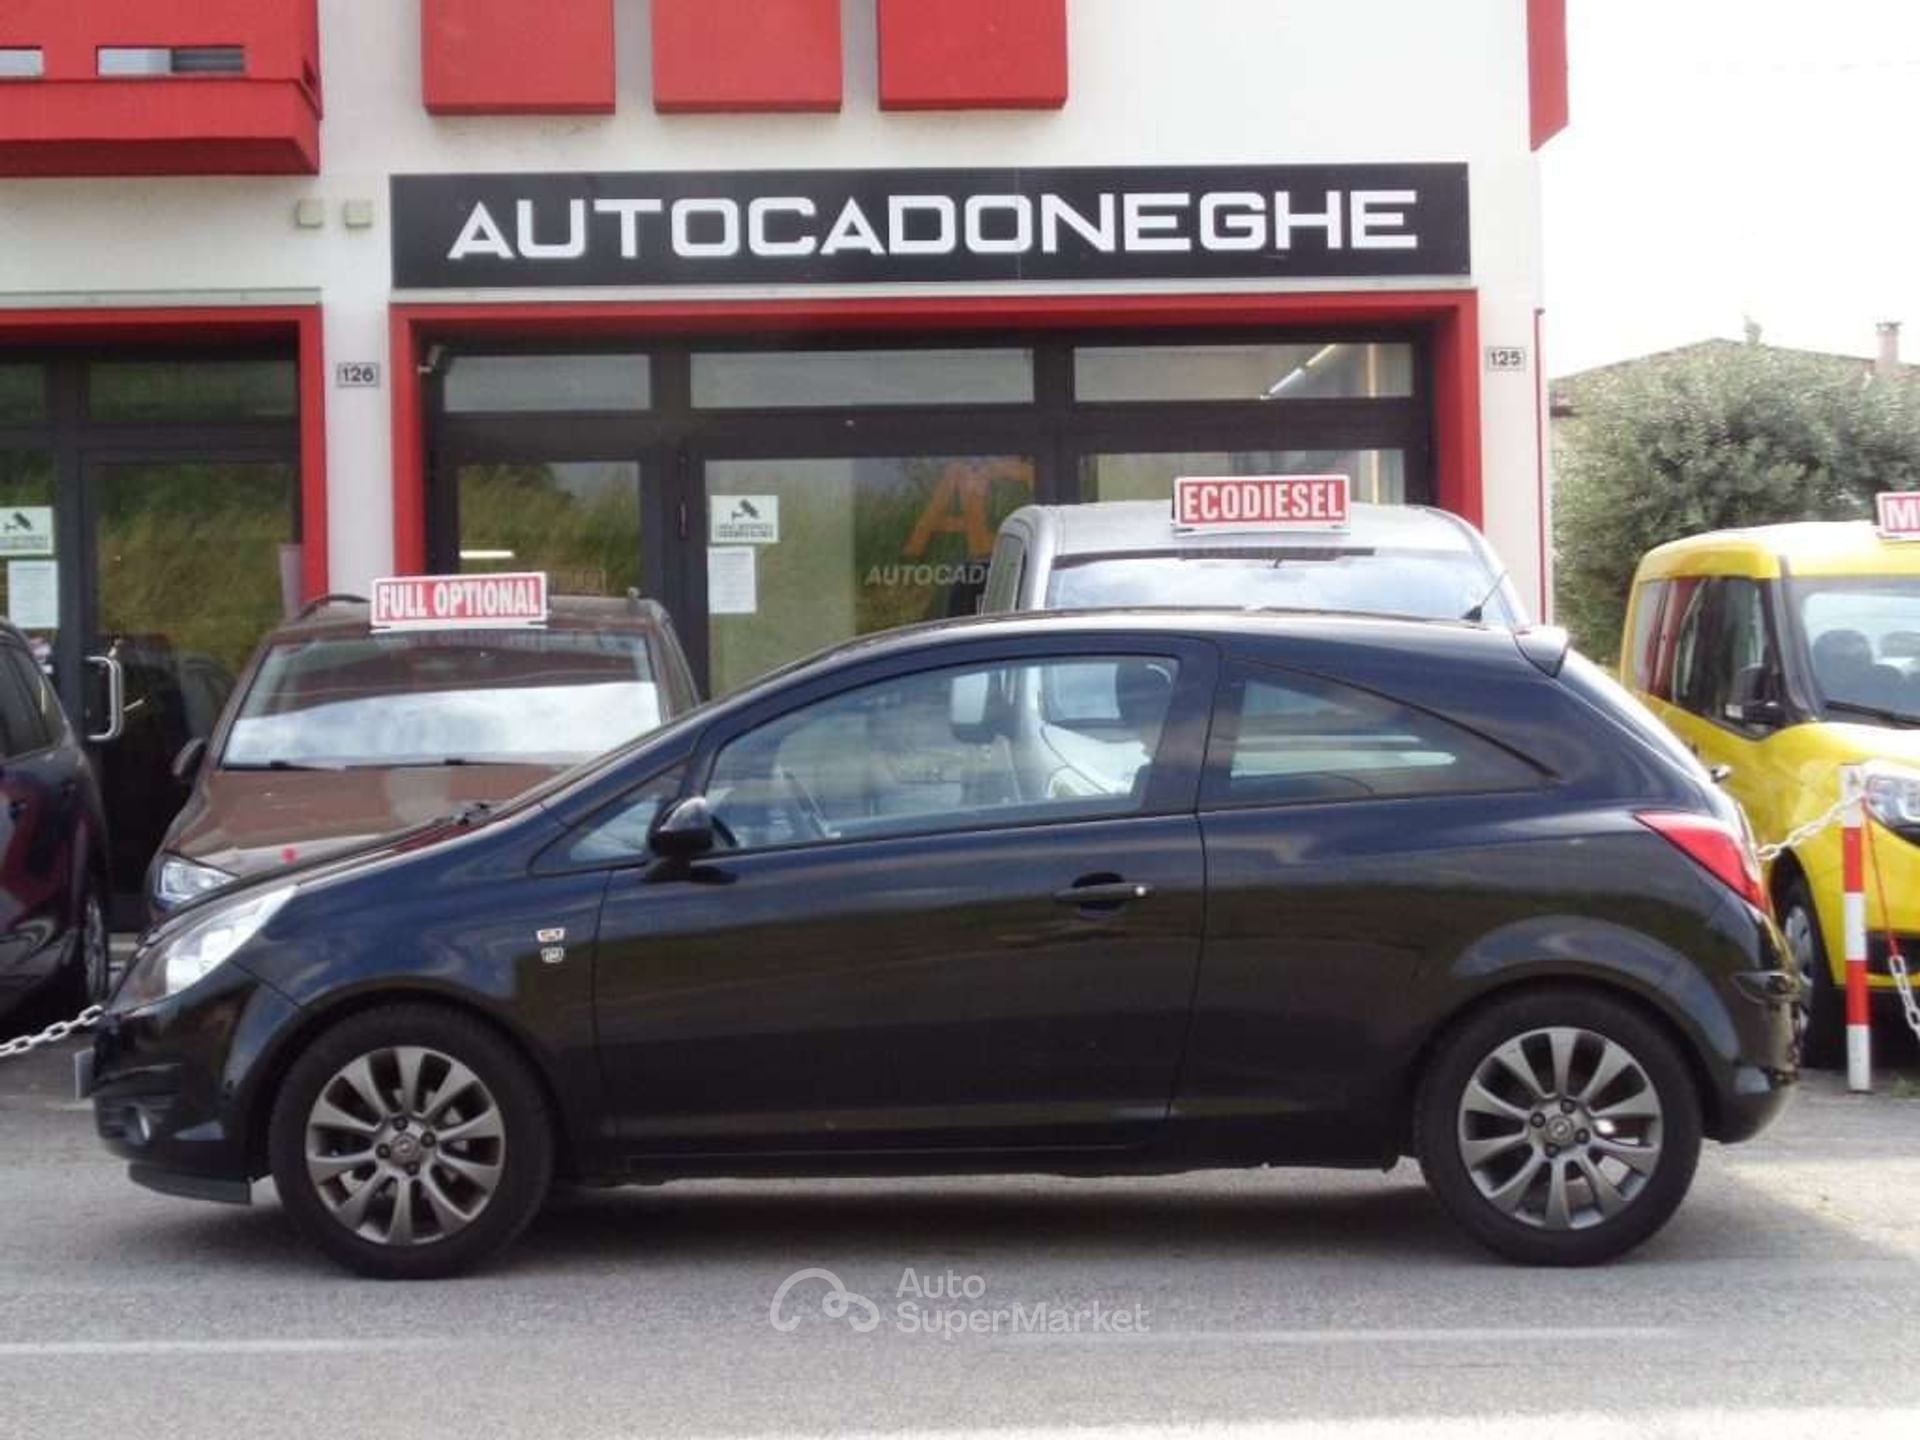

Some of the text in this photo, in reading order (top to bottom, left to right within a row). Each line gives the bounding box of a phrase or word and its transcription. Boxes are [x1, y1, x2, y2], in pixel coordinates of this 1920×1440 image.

[448, 189, 1417, 259] AUTOCADONEGHE
[1490, 350, 1521, 366] 125
[343, 366, 374, 383] 126
[1182, 481, 1343, 520] ECODIESEL
[864, 564, 991, 586] AUTOCAD
[377, 580, 538, 619] FULL OPTIONAL
